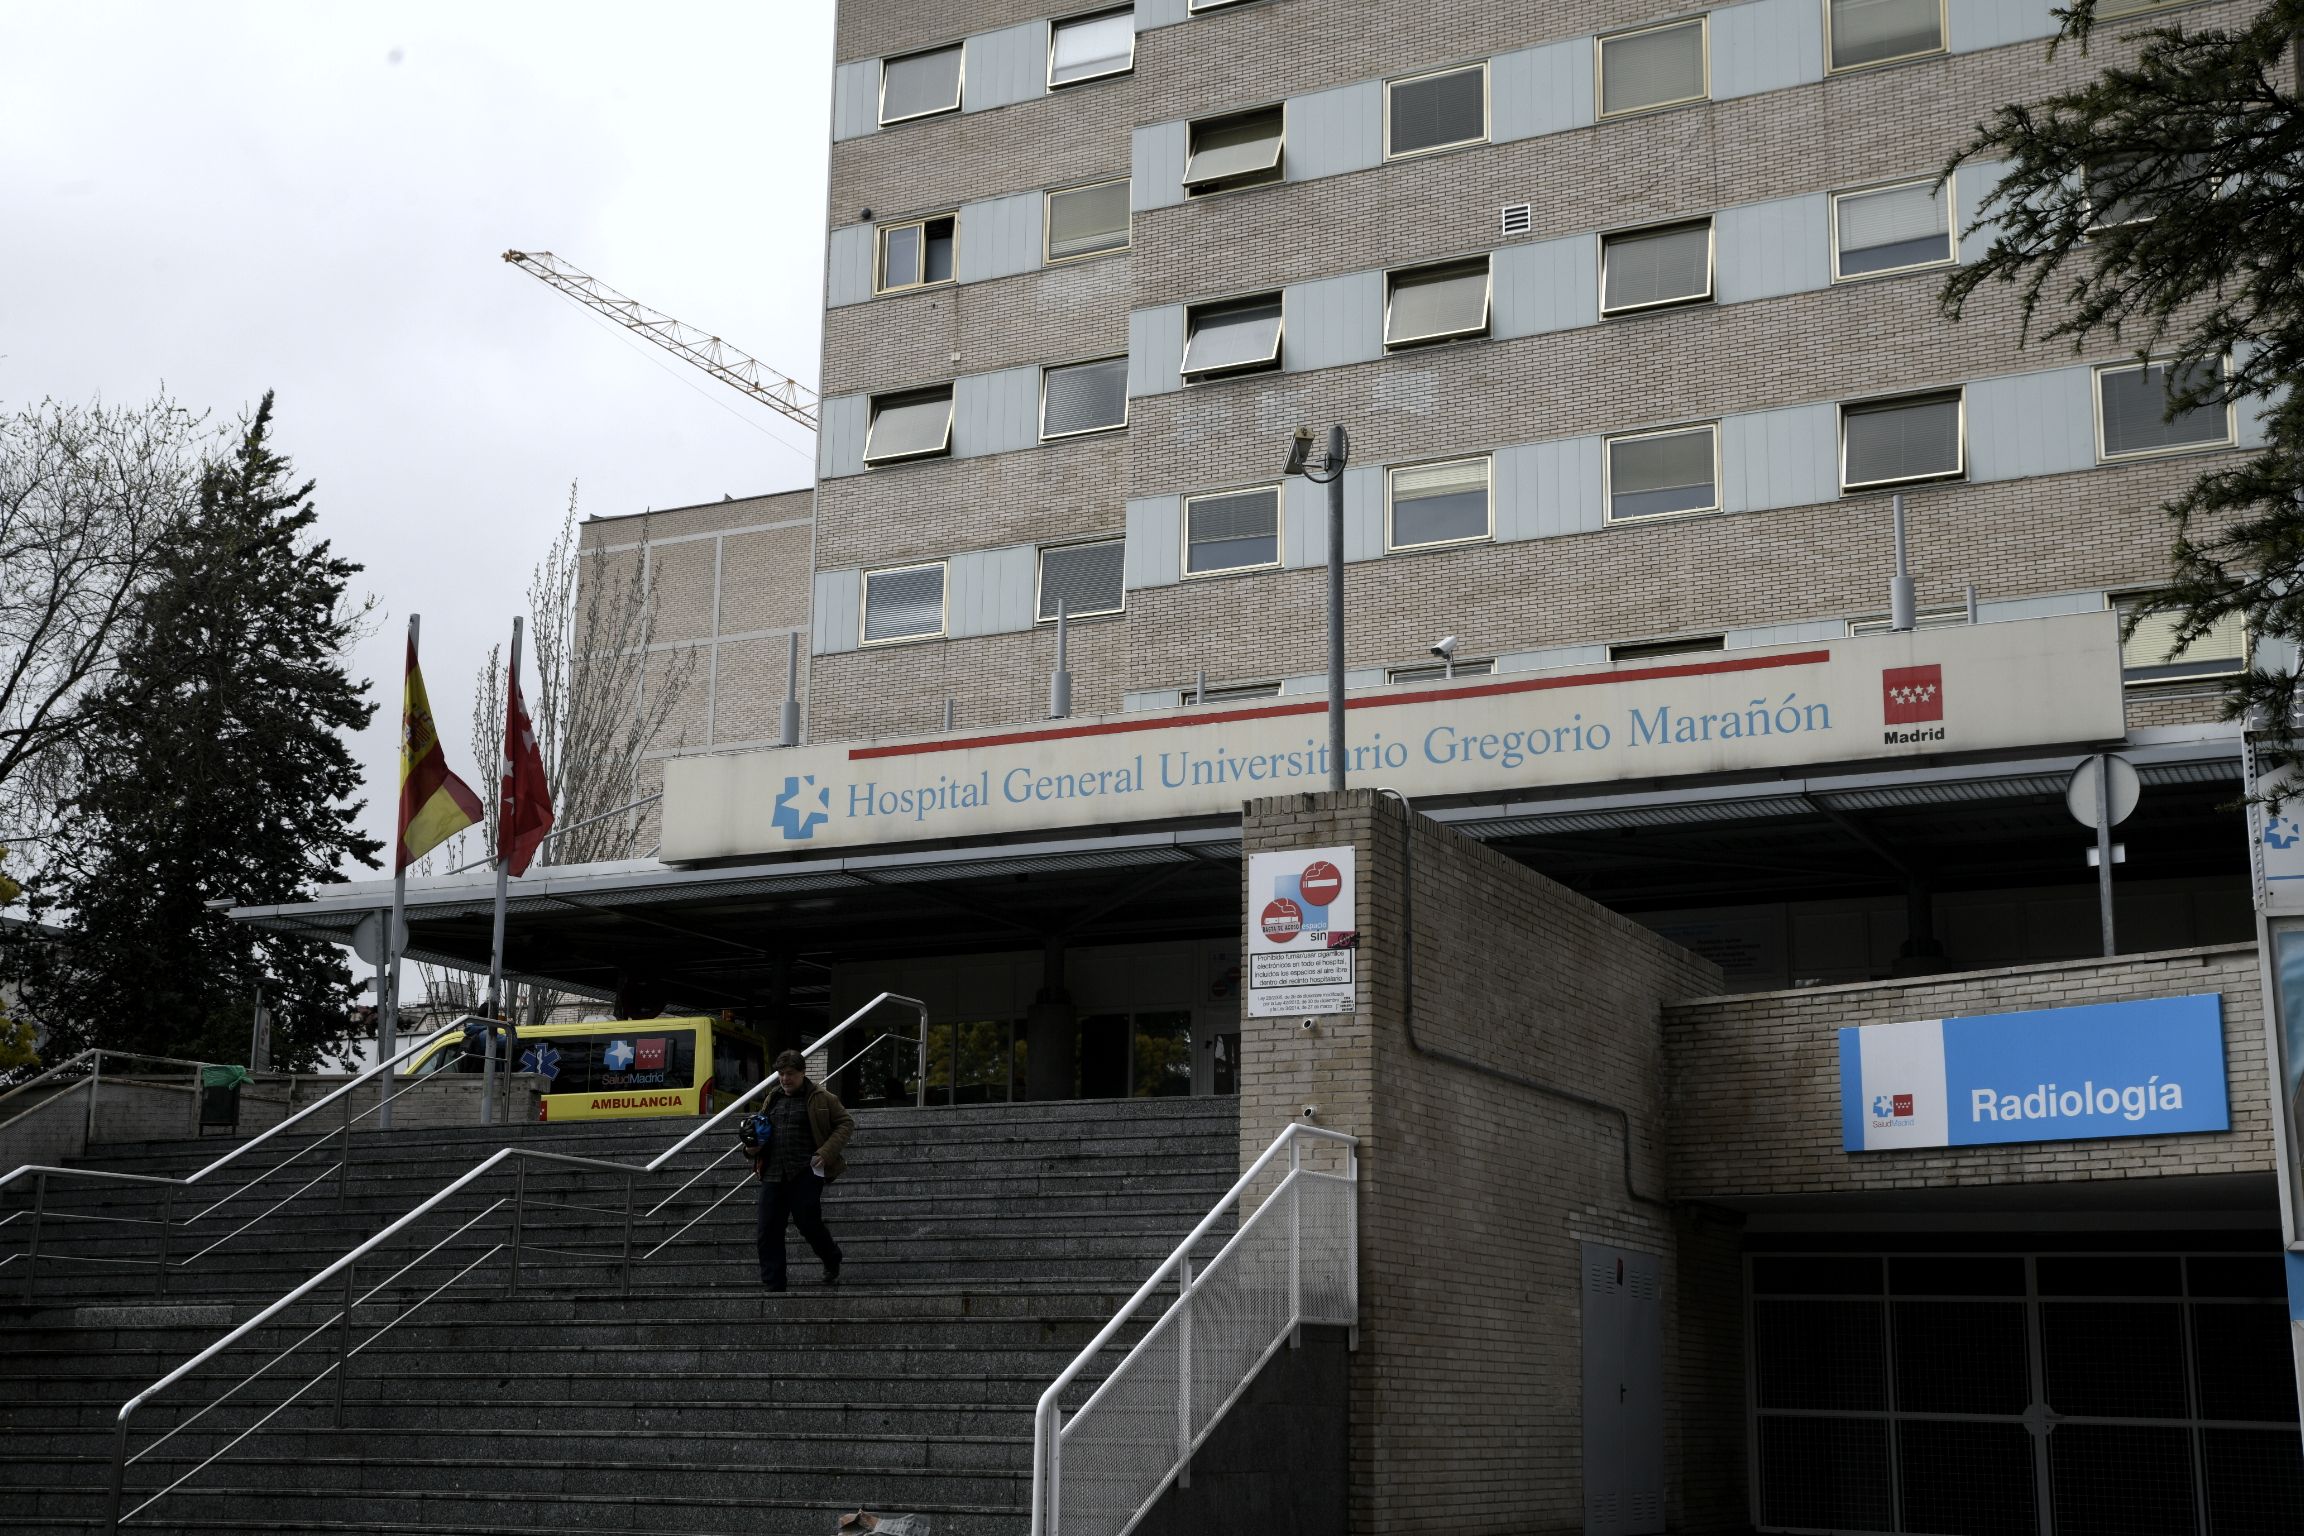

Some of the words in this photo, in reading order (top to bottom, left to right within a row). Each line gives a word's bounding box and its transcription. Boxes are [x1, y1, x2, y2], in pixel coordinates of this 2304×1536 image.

[1884, 726, 1945, 746] Madrid
[846, 772, 990, 822] Hospital
[1003, 756, 1145, 805] General
[1423, 714, 1611, 770] Gregorio
[1629, 694, 1832, 748] Marañón
[1302, 921, 1327, 930] espacio
[1310, 929, 1327, 941] sin
[1257, 953, 1285, 961] Prohibido
[602, 1072, 664, 1085] SaludMadrid
[591, 1096, 682, 1110] AMBULANCIA
[1971, 1076, 2183, 1123] Radiología
